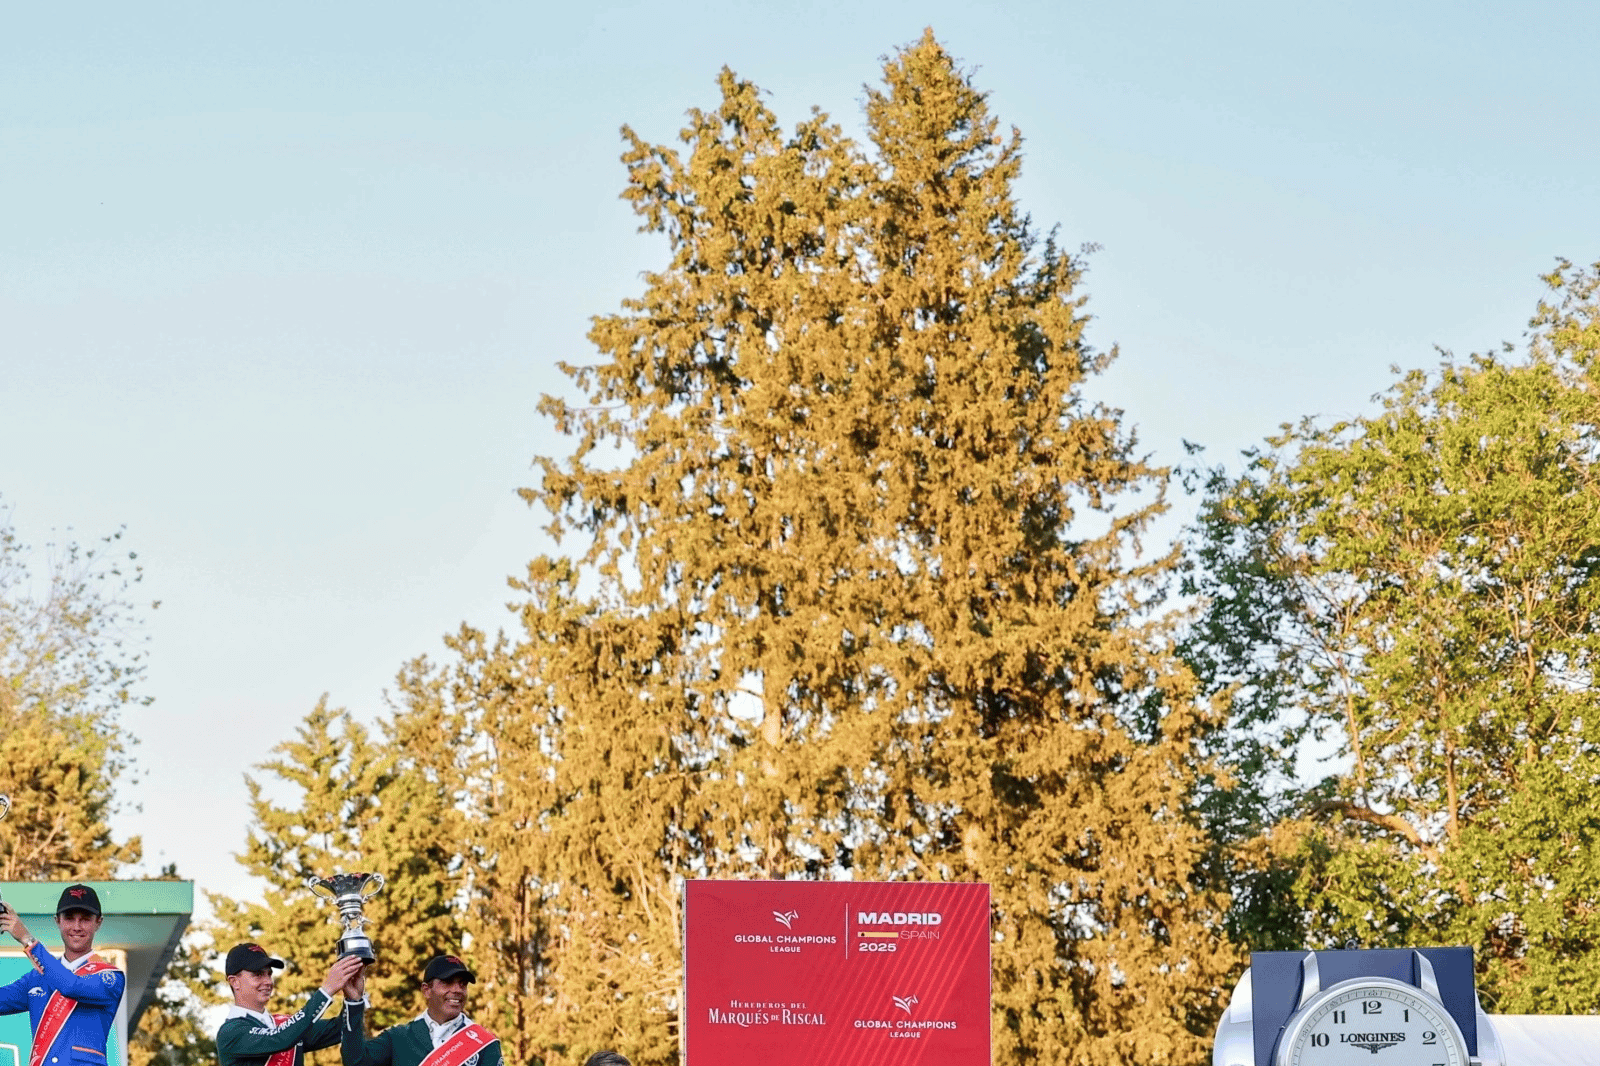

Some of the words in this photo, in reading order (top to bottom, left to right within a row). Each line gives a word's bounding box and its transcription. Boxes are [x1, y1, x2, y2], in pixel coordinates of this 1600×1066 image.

[858, 912, 941, 925] MADRID
[735, 935, 773, 943] GLOBAL
[777, 935, 836, 944] CHAMPIONS
[901, 931, 939, 939] SPAIN
[859, 943, 896, 952] 2025
[731, 1000, 786, 1008] HEREDEROS
[1362, 1000, 1382, 1014] 12
[709, 1008, 769, 1027] MARQUÉS
[782, 1009, 825, 1025] RISCAL
[1333, 1010, 1346, 1024] 11
[1404, 1009, 1408, 1022] 1
[854, 1020, 893, 1028] GLOBAL
[896, 1021, 957, 1029] CHAMPIONS
[1310, 1033, 1330, 1047] 10
[1340, 1032, 1406, 1042] LONGINES
[1422, 1031, 1436, 1045] 2
